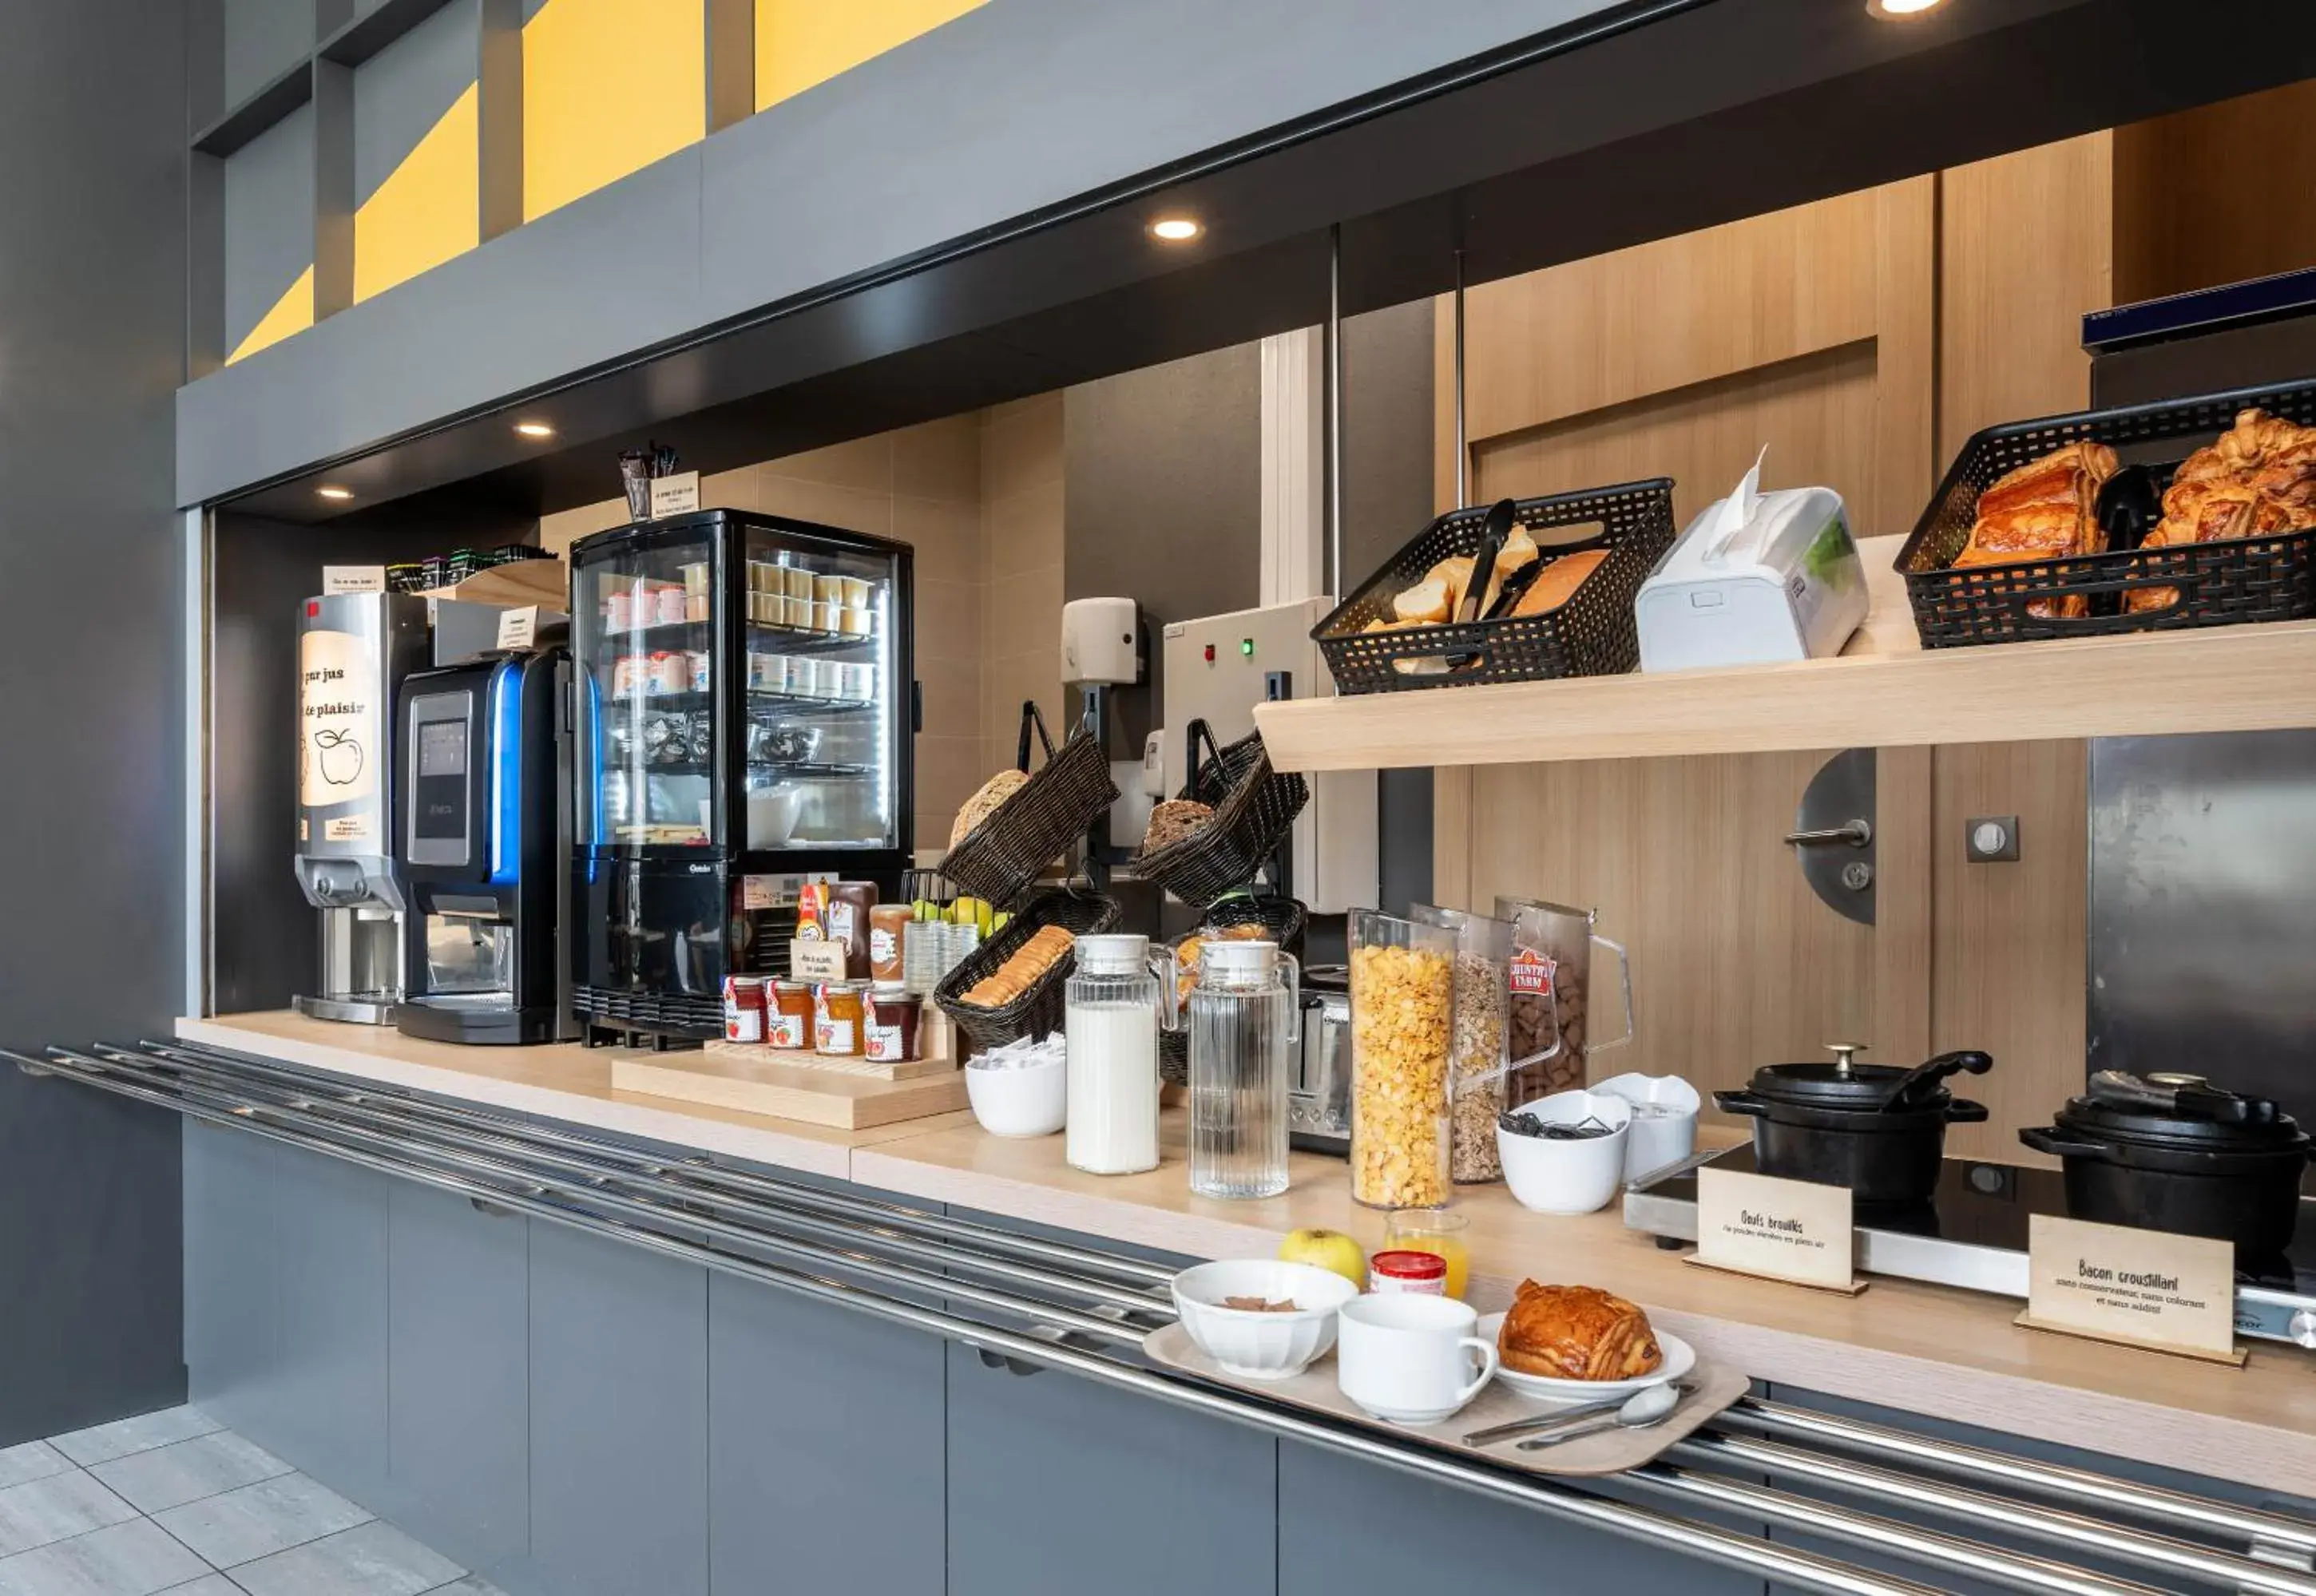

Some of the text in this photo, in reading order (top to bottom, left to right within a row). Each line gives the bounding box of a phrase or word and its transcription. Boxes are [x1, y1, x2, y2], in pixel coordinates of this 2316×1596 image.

[323, 667, 344, 683] jus
[2079, 1258, 2179, 1291] Bacon croustillant
